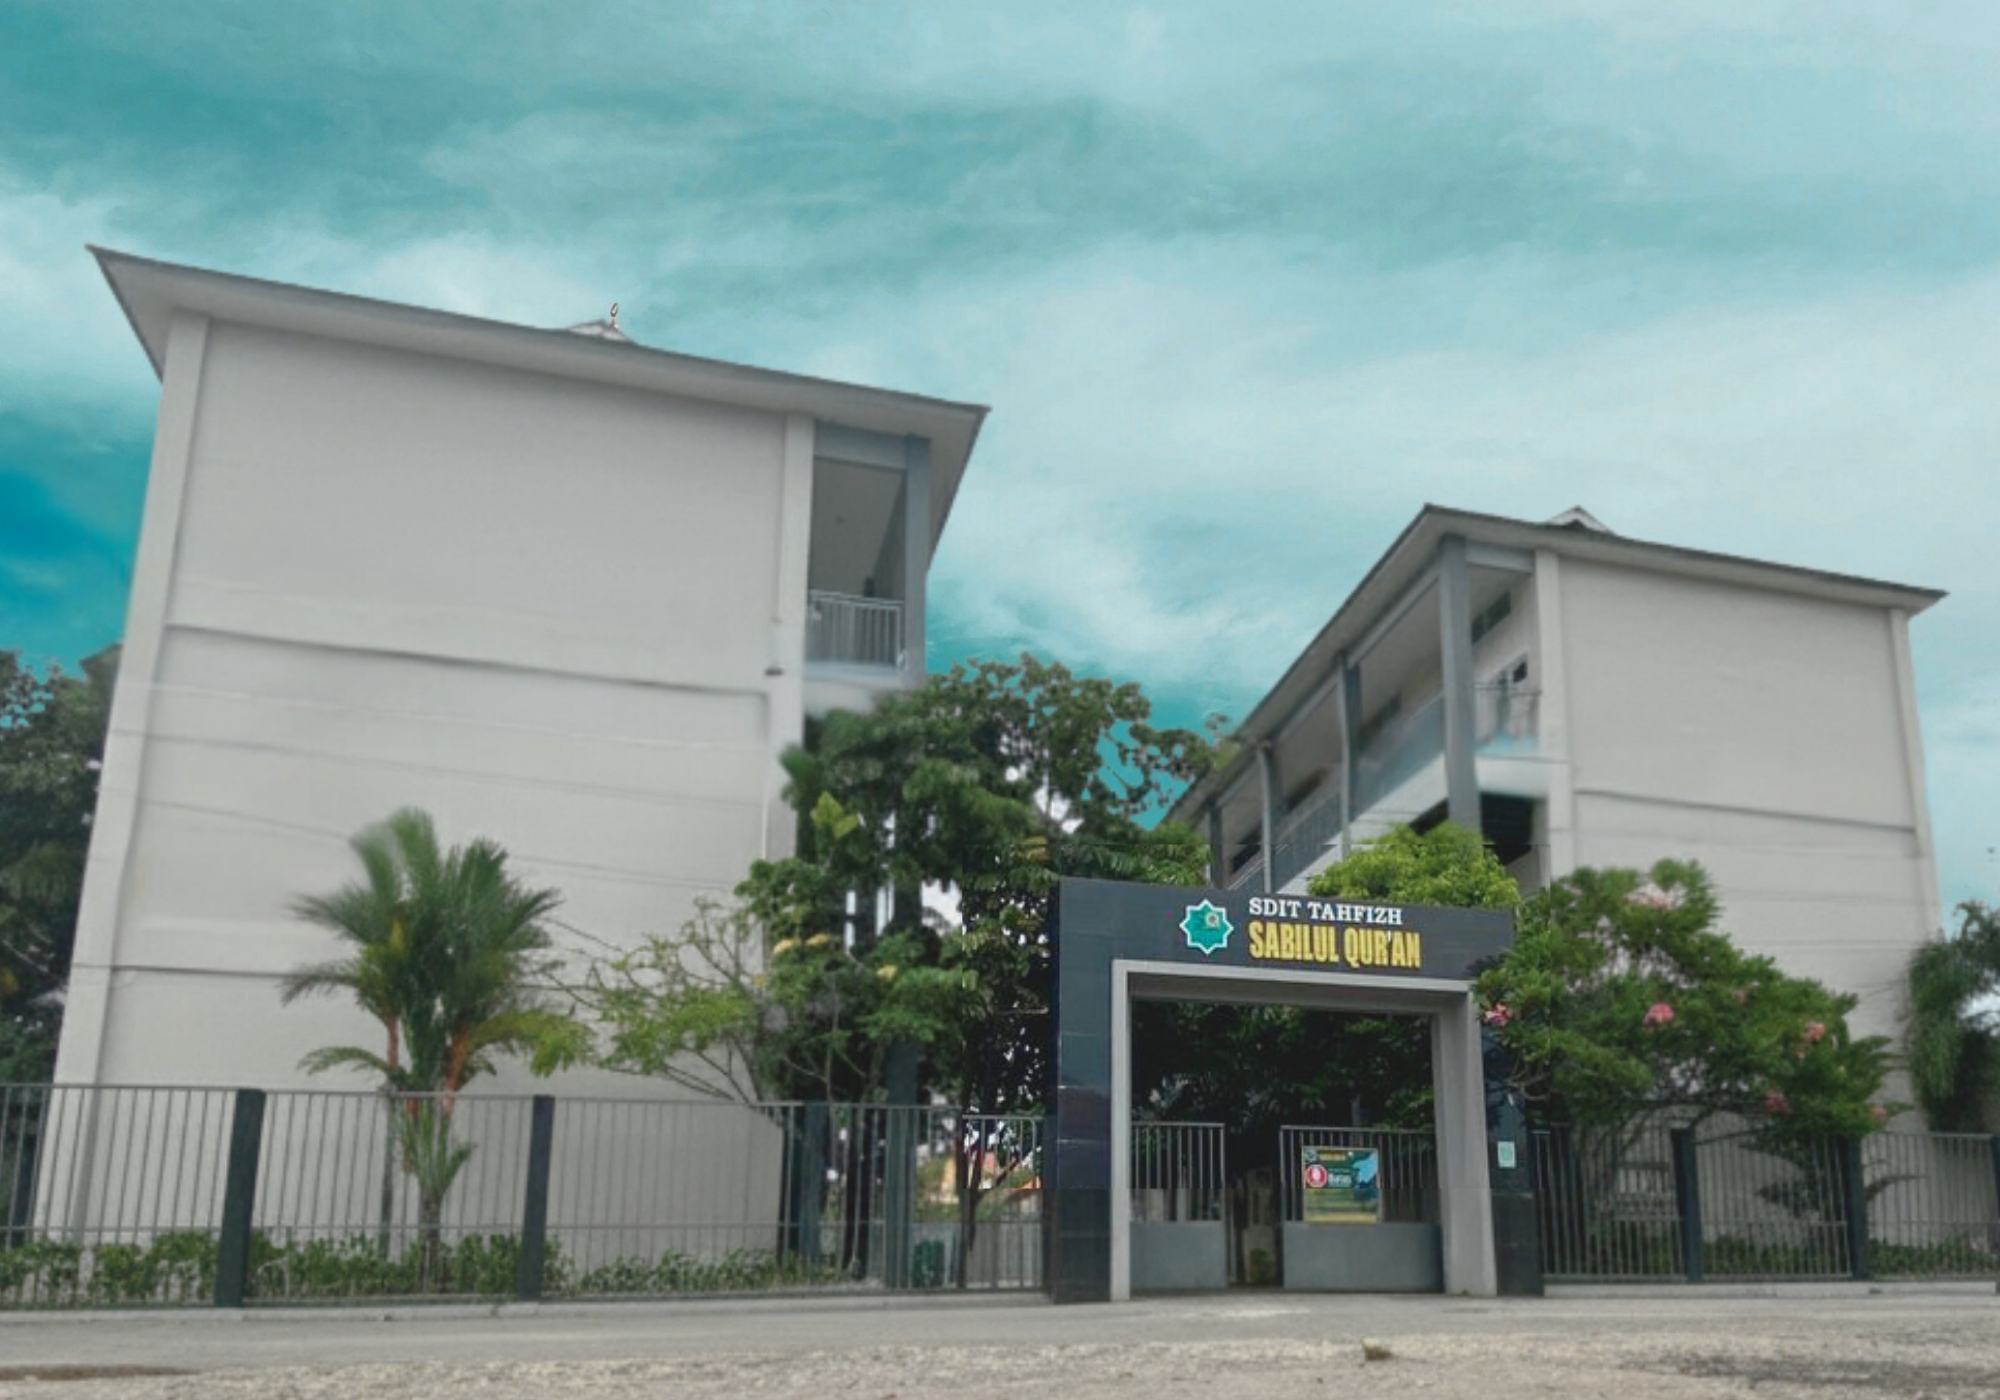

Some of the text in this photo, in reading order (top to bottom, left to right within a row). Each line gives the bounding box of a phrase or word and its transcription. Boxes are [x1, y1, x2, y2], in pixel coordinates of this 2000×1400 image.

[1249, 897, 1403, 925] SDIT TAHFIZH
[1249, 920, 1421, 968] SABILUL QUR'AN
